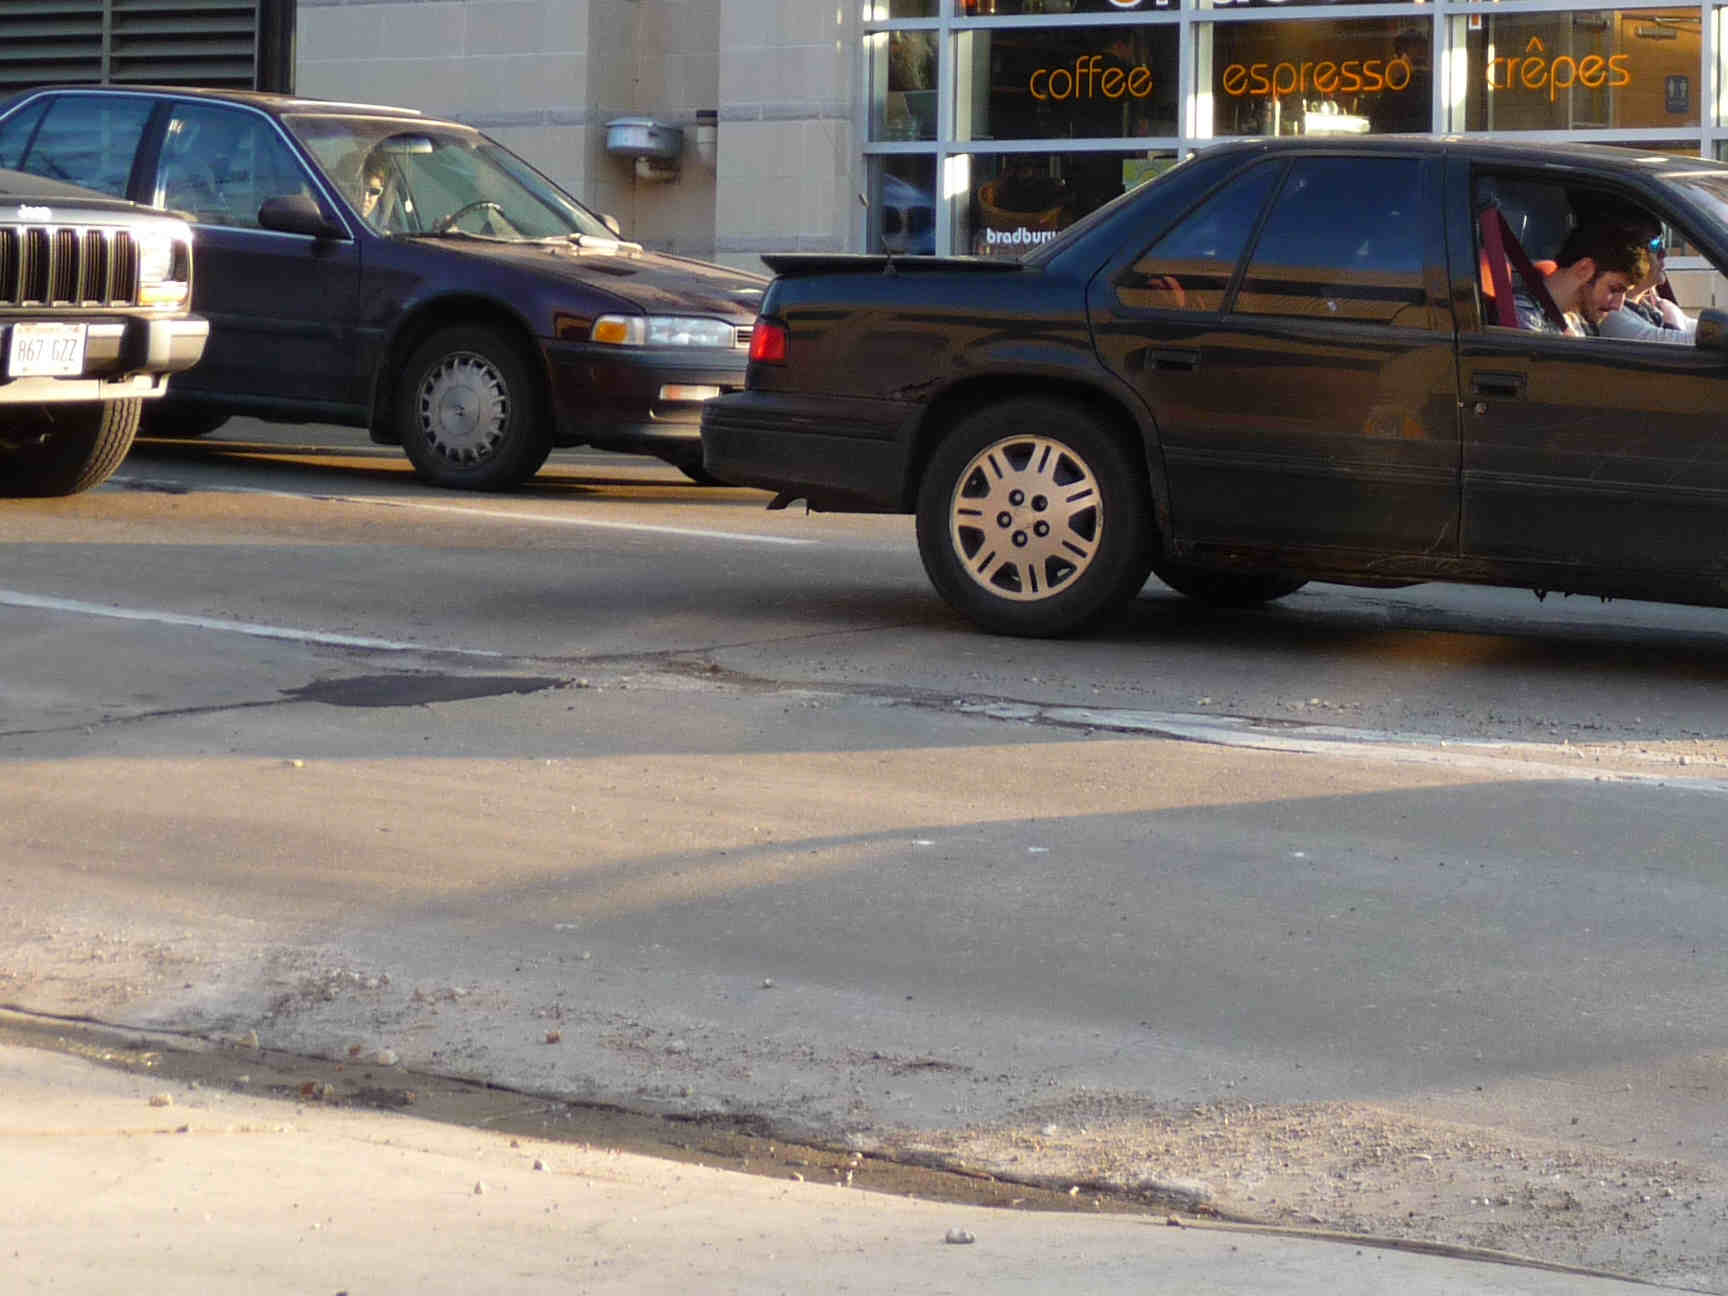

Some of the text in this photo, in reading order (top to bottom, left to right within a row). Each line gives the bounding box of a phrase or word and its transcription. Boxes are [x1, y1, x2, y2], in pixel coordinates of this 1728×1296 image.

[1029, 35, 1632, 103] coffee espresso crêpes
